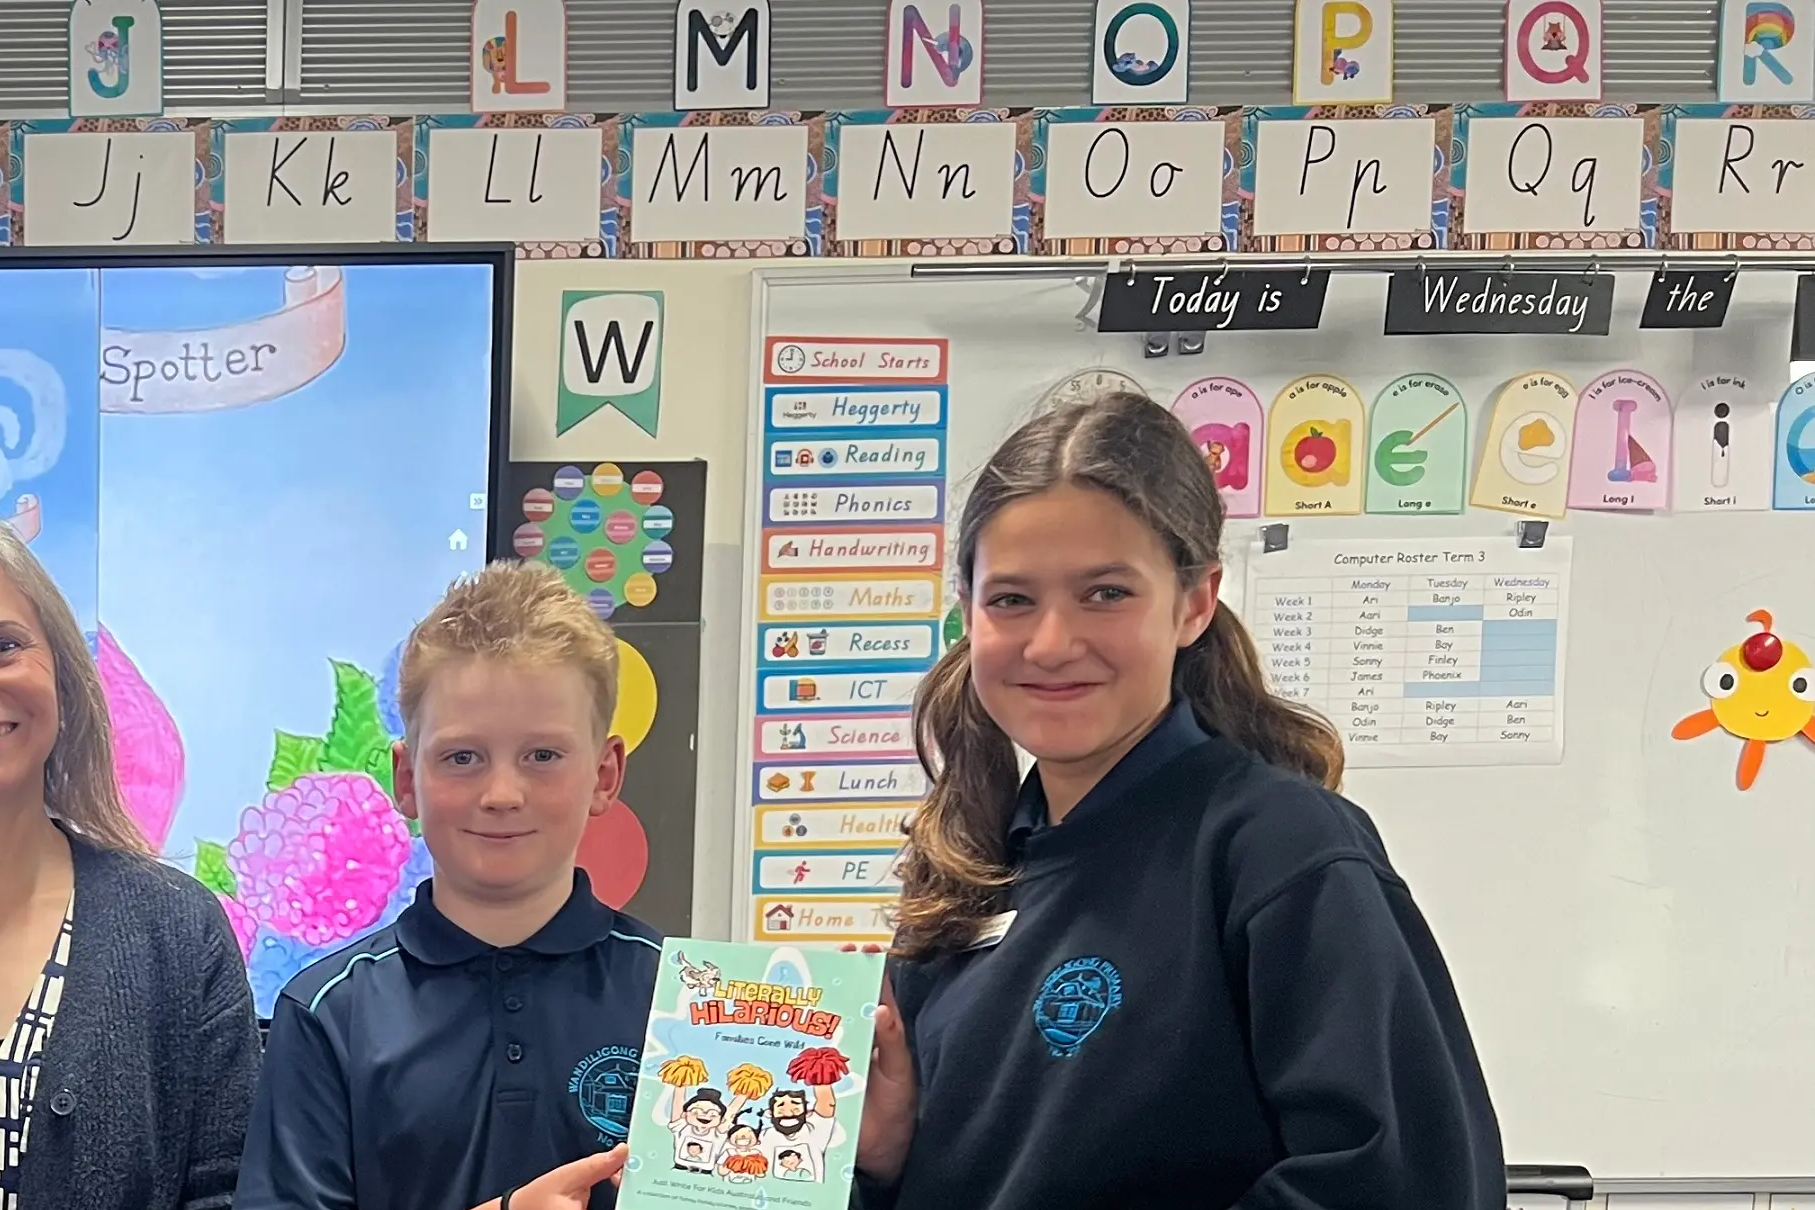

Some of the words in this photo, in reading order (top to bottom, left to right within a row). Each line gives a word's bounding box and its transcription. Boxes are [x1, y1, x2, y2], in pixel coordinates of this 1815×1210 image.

[687, 8, 757, 92] M
[900, 5, 960, 88] N
[1104, 1, 1178, 86] O
[1321, 2, 1373, 86] P
[1517, 0, 1589, 84] Q
[1744, 2, 1794, 86] R
[88, 17, 134, 98] J
[505, 10, 550, 94] L
[1151, 276, 1240, 328] Today
[1257, 281, 1281, 313] is
[1424, 276, 1588, 331] Wednesday
[1667, 282, 1714, 313] the
[573, 320, 653, 383] W
[810, 351, 866, 369] School
[878, 352, 930, 370] Starts
[99, 342, 277, 402] Spotter
[1322, 382, 1348, 398] apple
[1425, 382, 1450, 396] erase
[1553, 383, 1569, 399] egg
[833, 397, 921, 423] Heggerty
[845, 444, 926, 470] Reading
[835, 494, 912, 514] Phonics
[1295, 500, 1323, 510] Short
[1398, 500, 1423, 510] Long
[1501, 496, 1529, 508] Short
[1603, 494, 1628, 505] Long
[1704, 497, 1731, 505] Short
[809, 540, 930, 563] Handwriting
[1334, 553, 1393, 566] Computer
[1397, 552, 1438, 564] Roster
[1442, 551, 1474, 563] Term
[1477, 551, 1486, 563] 3
[1351, 580, 1390, 591] Monday
[1427, 578, 1468, 590] Tuesday
[1494, 577, 1550, 588] Wednesday
[849, 588, 914, 607] Maths
[1275, 597, 1306, 606] Week
[1362, 595, 1378, 605] Ari
[1432, 593, 1461, 604] Banjo
[1506, 592, 1536, 604] Ripley
[1274, 612, 1304, 621] Week
[1508, 607, 1533, 617] Odin
[1273, 627, 1304, 636] Week
[1355, 626, 1383, 636] Didge
[1436, 625, 1454, 634] Ben
[850, 633, 910, 652] Recess
[1272, 642, 1302, 651] Week
[1353, 641, 1383, 651] Vinnie
[1435, 640, 1453, 651] Bay
[1271, 658, 1302, 667] Week
[1352, 656, 1382, 668] Sonny
[1428, 655, 1458, 666] Finley
[1271, 673, 1302, 682] Week
[1350, 671, 1383, 682] James
[1422, 671, 1461, 680] Phoenix
[849, 680, 887, 700] ICT
[1351, 702, 1380, 713] Banjo
[1425, 701, 1456, 713] Ripley
[1352, 717, 1376, 727] Odin
[1426, 716, 1454, 727] Didge
[1507, 715, 1525, 724] Ben
[828, 725, 900, 745] Science
[1348, 732, 1378, 742] Vinnie
[1430, 731, 1448, 742] Bay
[1500, 730, 1531, 741] Sonny
[839, 771, 897, 791] Lunch
[842, 861, 869, 880] PE
[798, 909, 854, 927] Home
[714, 1032, 754, 1045] Families
[757, 1036, 781, 1047] Gone
[784, 1040, 805, 1049] Wild
[569, 1045, 639, 1093] WANDILIGONG
